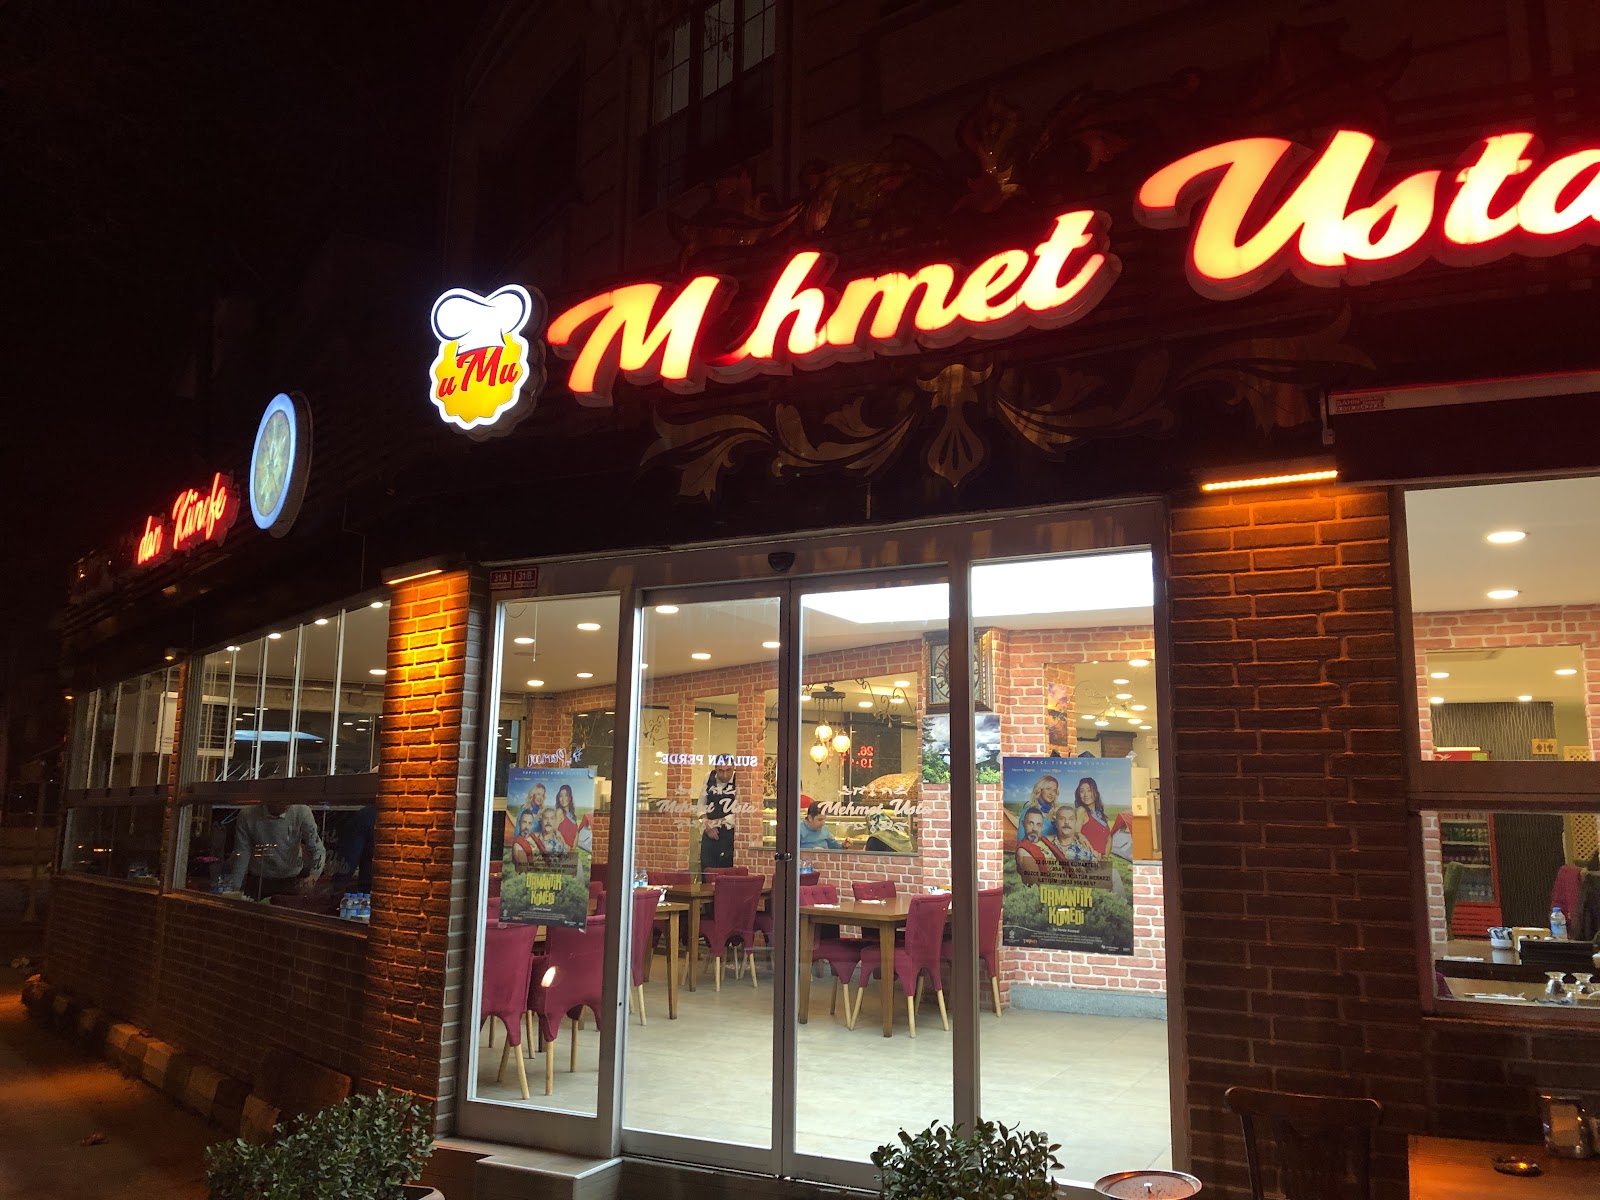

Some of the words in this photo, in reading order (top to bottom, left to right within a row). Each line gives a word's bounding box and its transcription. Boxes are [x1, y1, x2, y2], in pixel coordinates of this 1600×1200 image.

[547, 210, 1104, 393] Mhmet
[1138, 129, 1600, 280] Usta
[172, 472, 227, 549] Künefe
[719, 798, 758, 814] Usta
[817, 801, 884, 816] Mehmet
[889, 798, 933, 815] Usta
